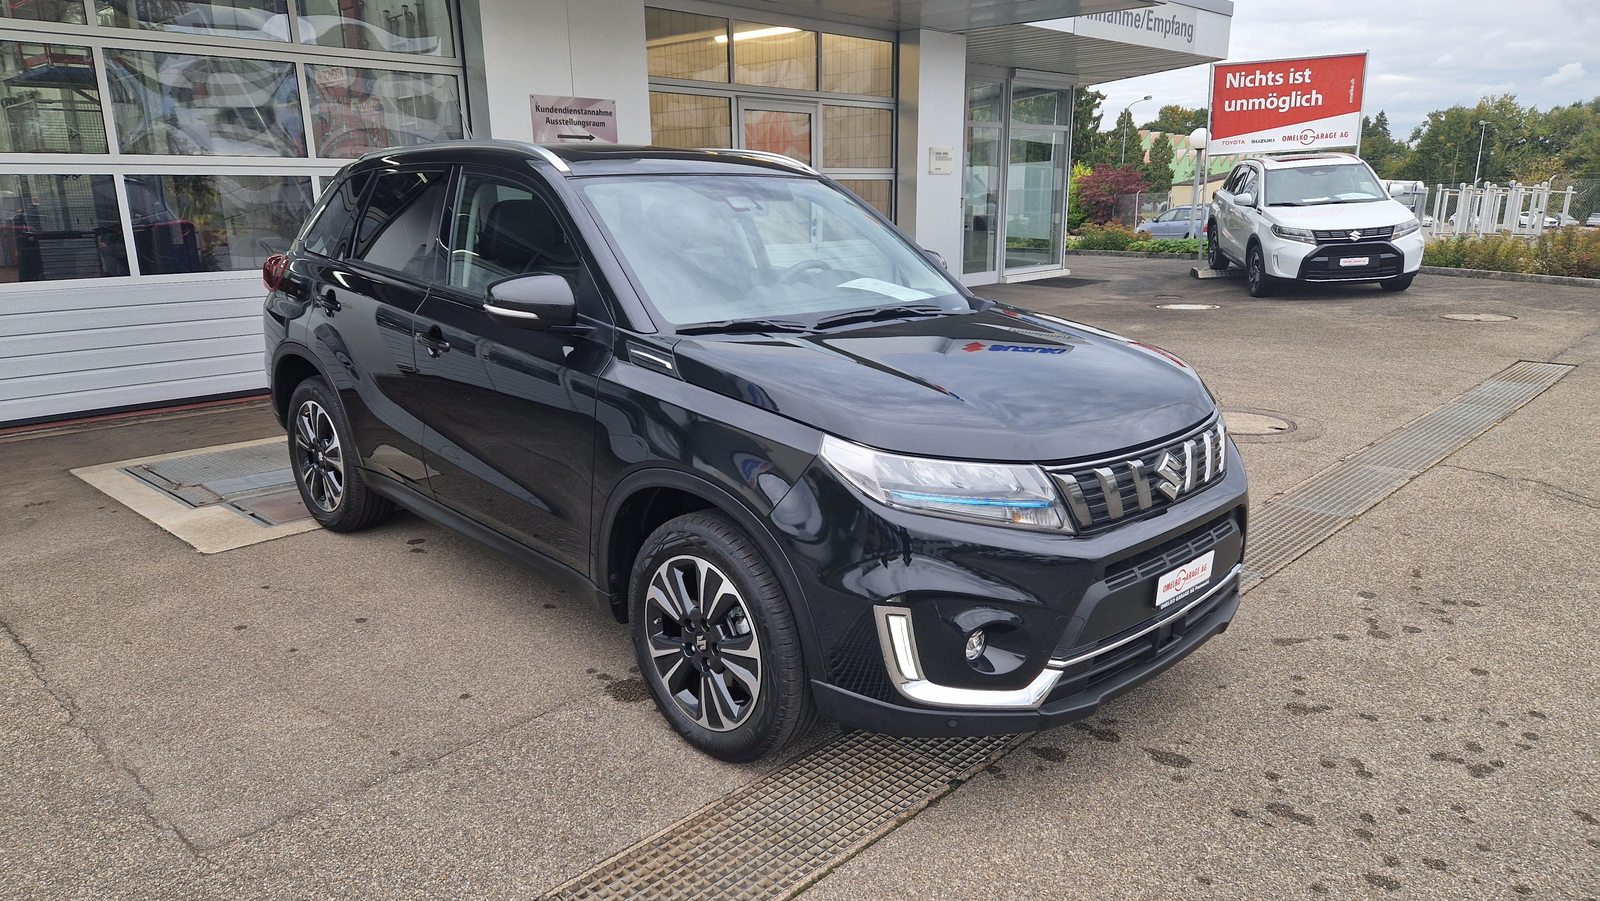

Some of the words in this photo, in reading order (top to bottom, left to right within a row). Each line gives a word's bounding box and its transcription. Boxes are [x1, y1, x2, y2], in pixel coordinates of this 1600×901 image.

[1225, 69, 1284, 89] Nichts
[1288, 67, 1312, 84] ist
[1224, 89, 1323, 113] unmöglich
[535, 104, 613, 117] Kundendienstannahme
[545, 117, 606, 129] Ausstellungsraum
[1282, 133, 1308, 142] OMELKO
[1339, 131, 1349, 139] AG
